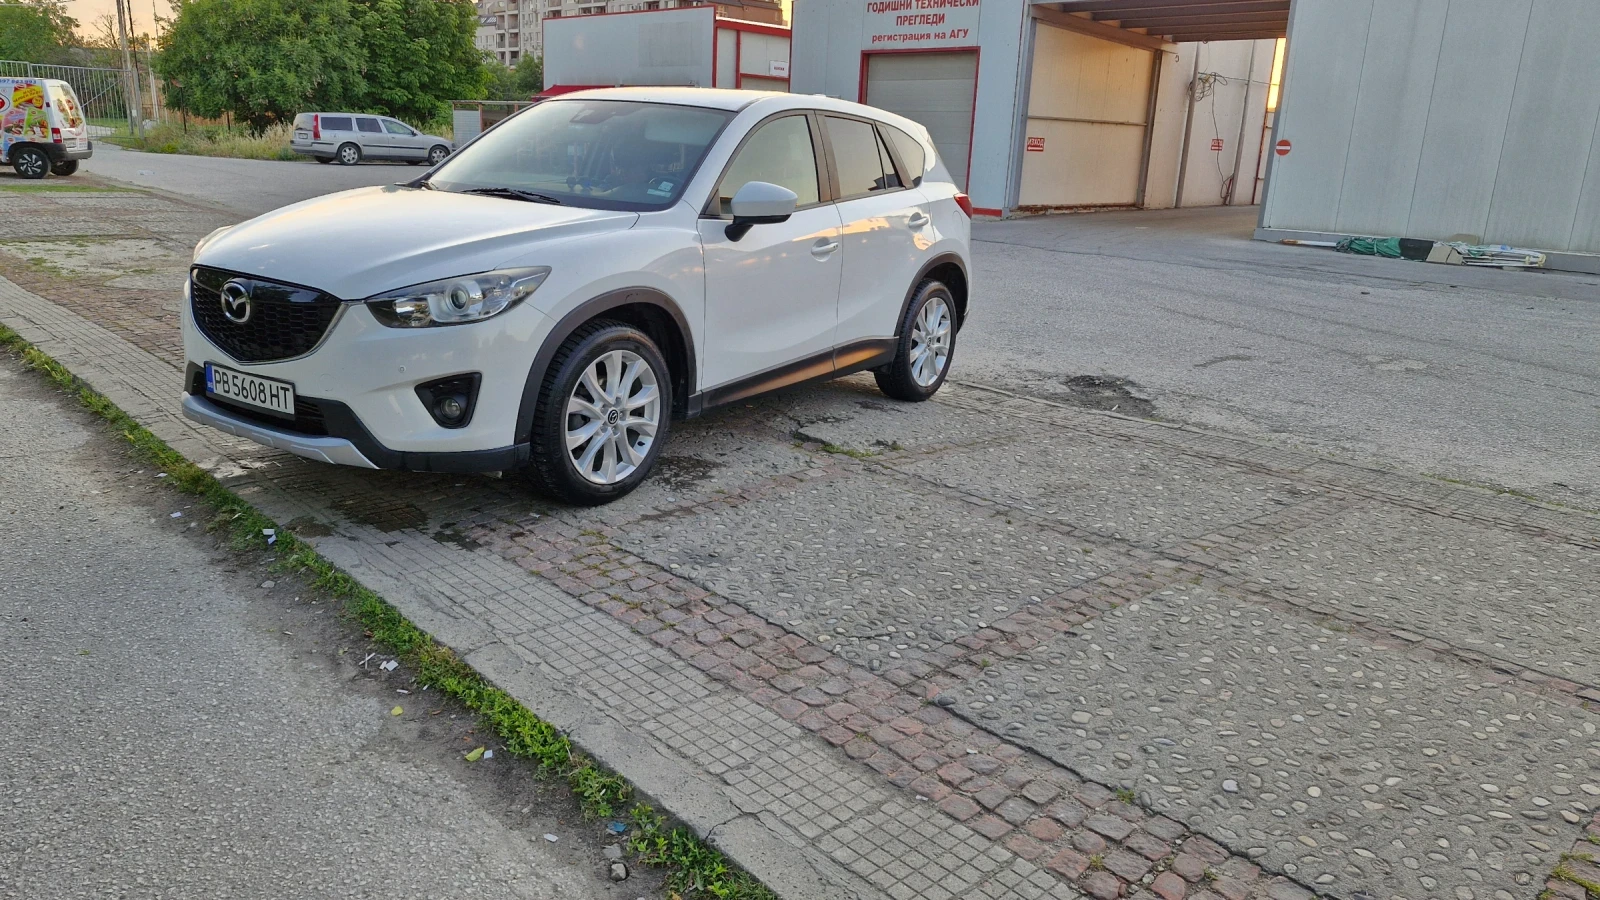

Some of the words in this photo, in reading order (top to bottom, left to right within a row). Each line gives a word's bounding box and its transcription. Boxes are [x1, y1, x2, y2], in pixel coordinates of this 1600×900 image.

[867, 0, 912, 14] ГОДИШНИ
[915, 0, 979, 9] ТЕХНИЧЕСКИ
[896, 13, 945, 26] ПРЕГЛЕДИ
[872, 32, 931, 44] регистрация
[949, 28, 969, 39] АГУ
[1028, 138, 1044, 147] ИЗХОД
